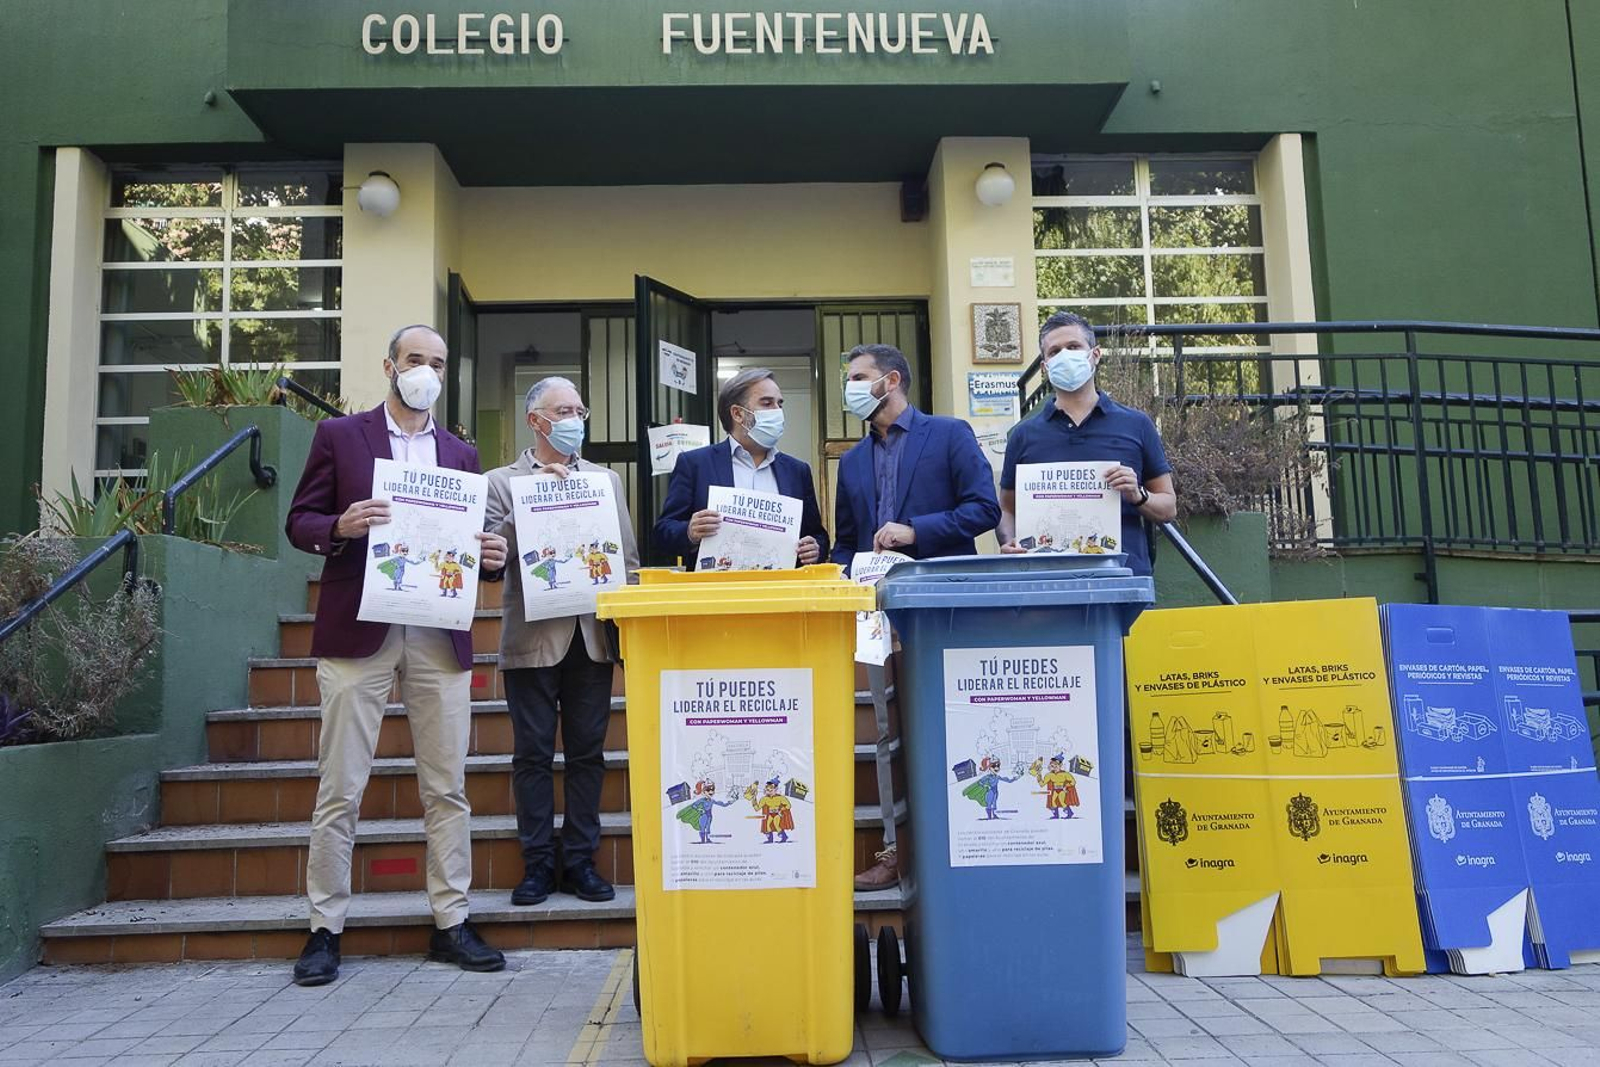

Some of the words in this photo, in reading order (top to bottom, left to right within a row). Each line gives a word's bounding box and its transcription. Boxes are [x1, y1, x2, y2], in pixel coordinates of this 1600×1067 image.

[361, 13, 565, 55] COLEGIO
[662, 12, 995, 55] FUENTENUEVA
[420, 473, 462, 491] PUEDES
[1056, 469, 1096, 481] PUEDES
[551, 478, 589, 492] PUEDES
[1024, 482, 1057, 491] LIDERAR
[1059, 482, 1068, 490] EL
[1070, 481, 1111, 490] RECICLAJE
[383, 481, 420, 495] LIDERAR
[422, 487, 432, 497] EL
[433, 488, 477, 504] RECICLAJE
[521, 493, 553, 505] LIDERAR
[555, 493, 563, 502] EL
[566, 489, 606, 500] RECICLAJE
[747, 497, 783, 514] PUEDES
[716, 504, 747, 516] LIDERAR
[748, 509, 757, 519] EL
[758, 511, 794, 526] RECICLAJE
[980, 656, 998, 676] TÚ
[1003, 659, 1058, 675] PUEDES
[1321, 664, 1348, 673] BRIKS
[1192, 671, 1219, 680] BRIKS
[1263, 677, 1269, 685] Y
[1272, 675, 1314, 684] ENVASES
[1316, 674, 1329, 682] DE
[1331, 671, 1376, 682] PLÁSTICO
[696, 678, 714, 698] TÚ
[719, 680, 776, 698] PUEDES
[957, 678, 1004, 691] LIDERAR
[1007, 678, 1019, 690] EL
[1023, 676, 1081, 690] RECICLAJE
[1143, 682, 1185, 691] ENVASES
[1186, 681, 1200, 689] DE
[1202, 678, 1246, 688] PLÁSTICO
[673, 700, 720, 713] LIDERAR
[723, 700, 736, 712] EL
[740, 698, 799, 712] RECICLAJE
[1200, 858, 1235, 870] inagra
[1332, 853, 1368, 865] inagra
[1467, 855, 1495, 868] inagra
[1566, 852, 1592, 864] inagra
